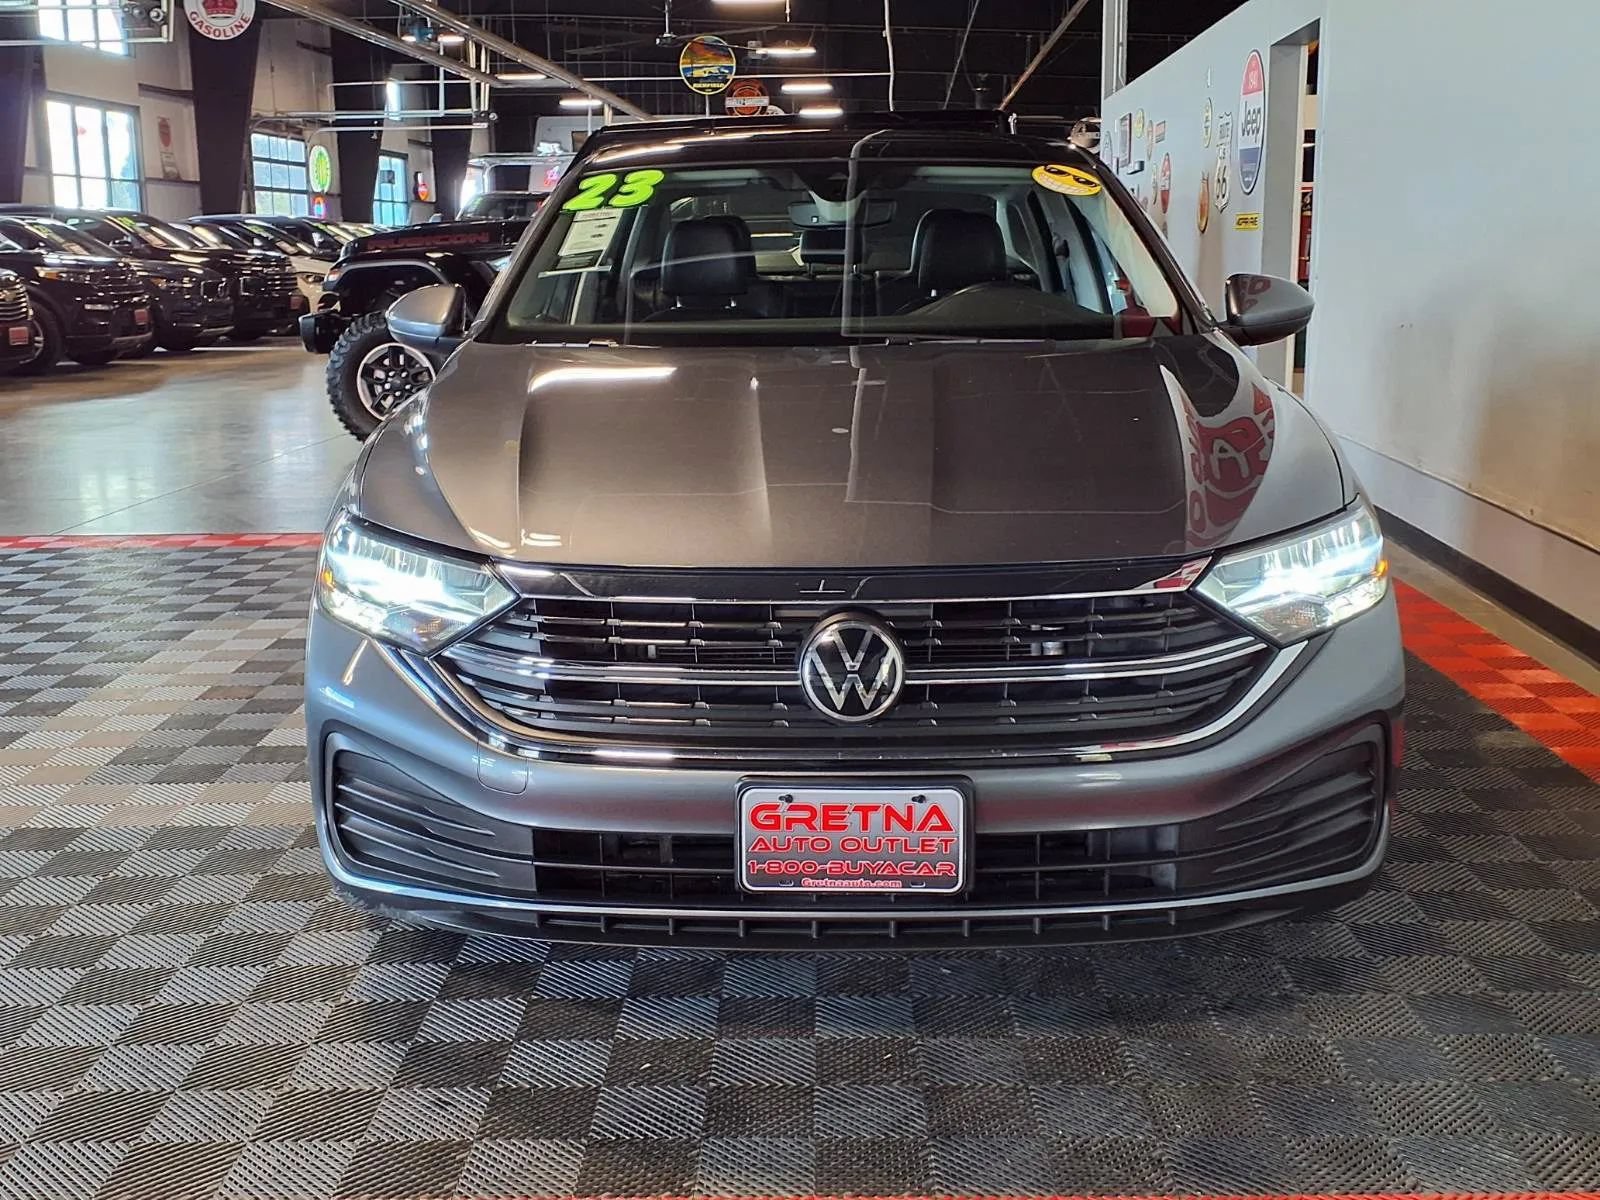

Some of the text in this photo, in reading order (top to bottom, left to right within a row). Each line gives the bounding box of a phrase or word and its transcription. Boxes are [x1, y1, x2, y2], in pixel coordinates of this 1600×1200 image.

[189, 11, 252, 38] GASOLINE
[1241, 100, 1262, 143] Jeep
[562, 169, 665, 210] 23
[1215, 164, 1228, 199] 66
[367, 232, 489, 250] RUBICON
[749, 802, 956, 834] GRETNA
[749, 837, 957, 854] AUTO OUTLET
[748, 859, 957, 877] 1-800-BUYACAR
[801, 876, 903, 889] Gretnaauto.com
